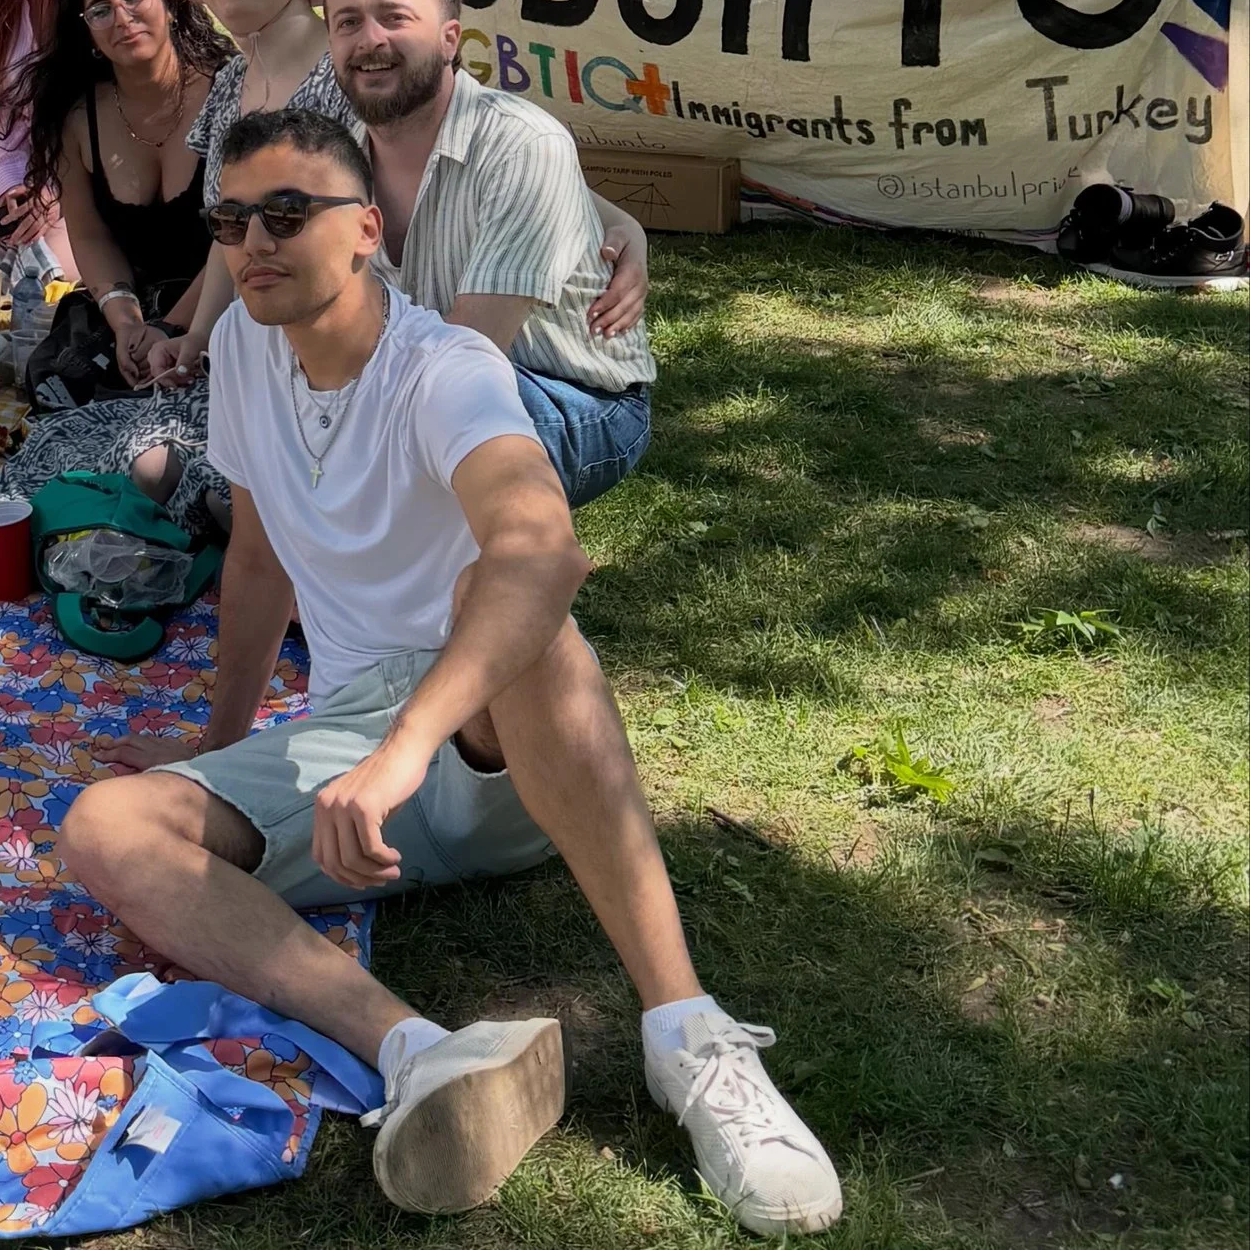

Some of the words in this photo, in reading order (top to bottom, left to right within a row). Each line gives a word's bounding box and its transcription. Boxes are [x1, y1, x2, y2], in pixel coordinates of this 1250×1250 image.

[458, 28, 671, 116] GBTIQ+
[671, 80, 876, 146] Immigrants
[888, 97, 988, 150] from
[1025, 75, 1214, 145] Turkey
